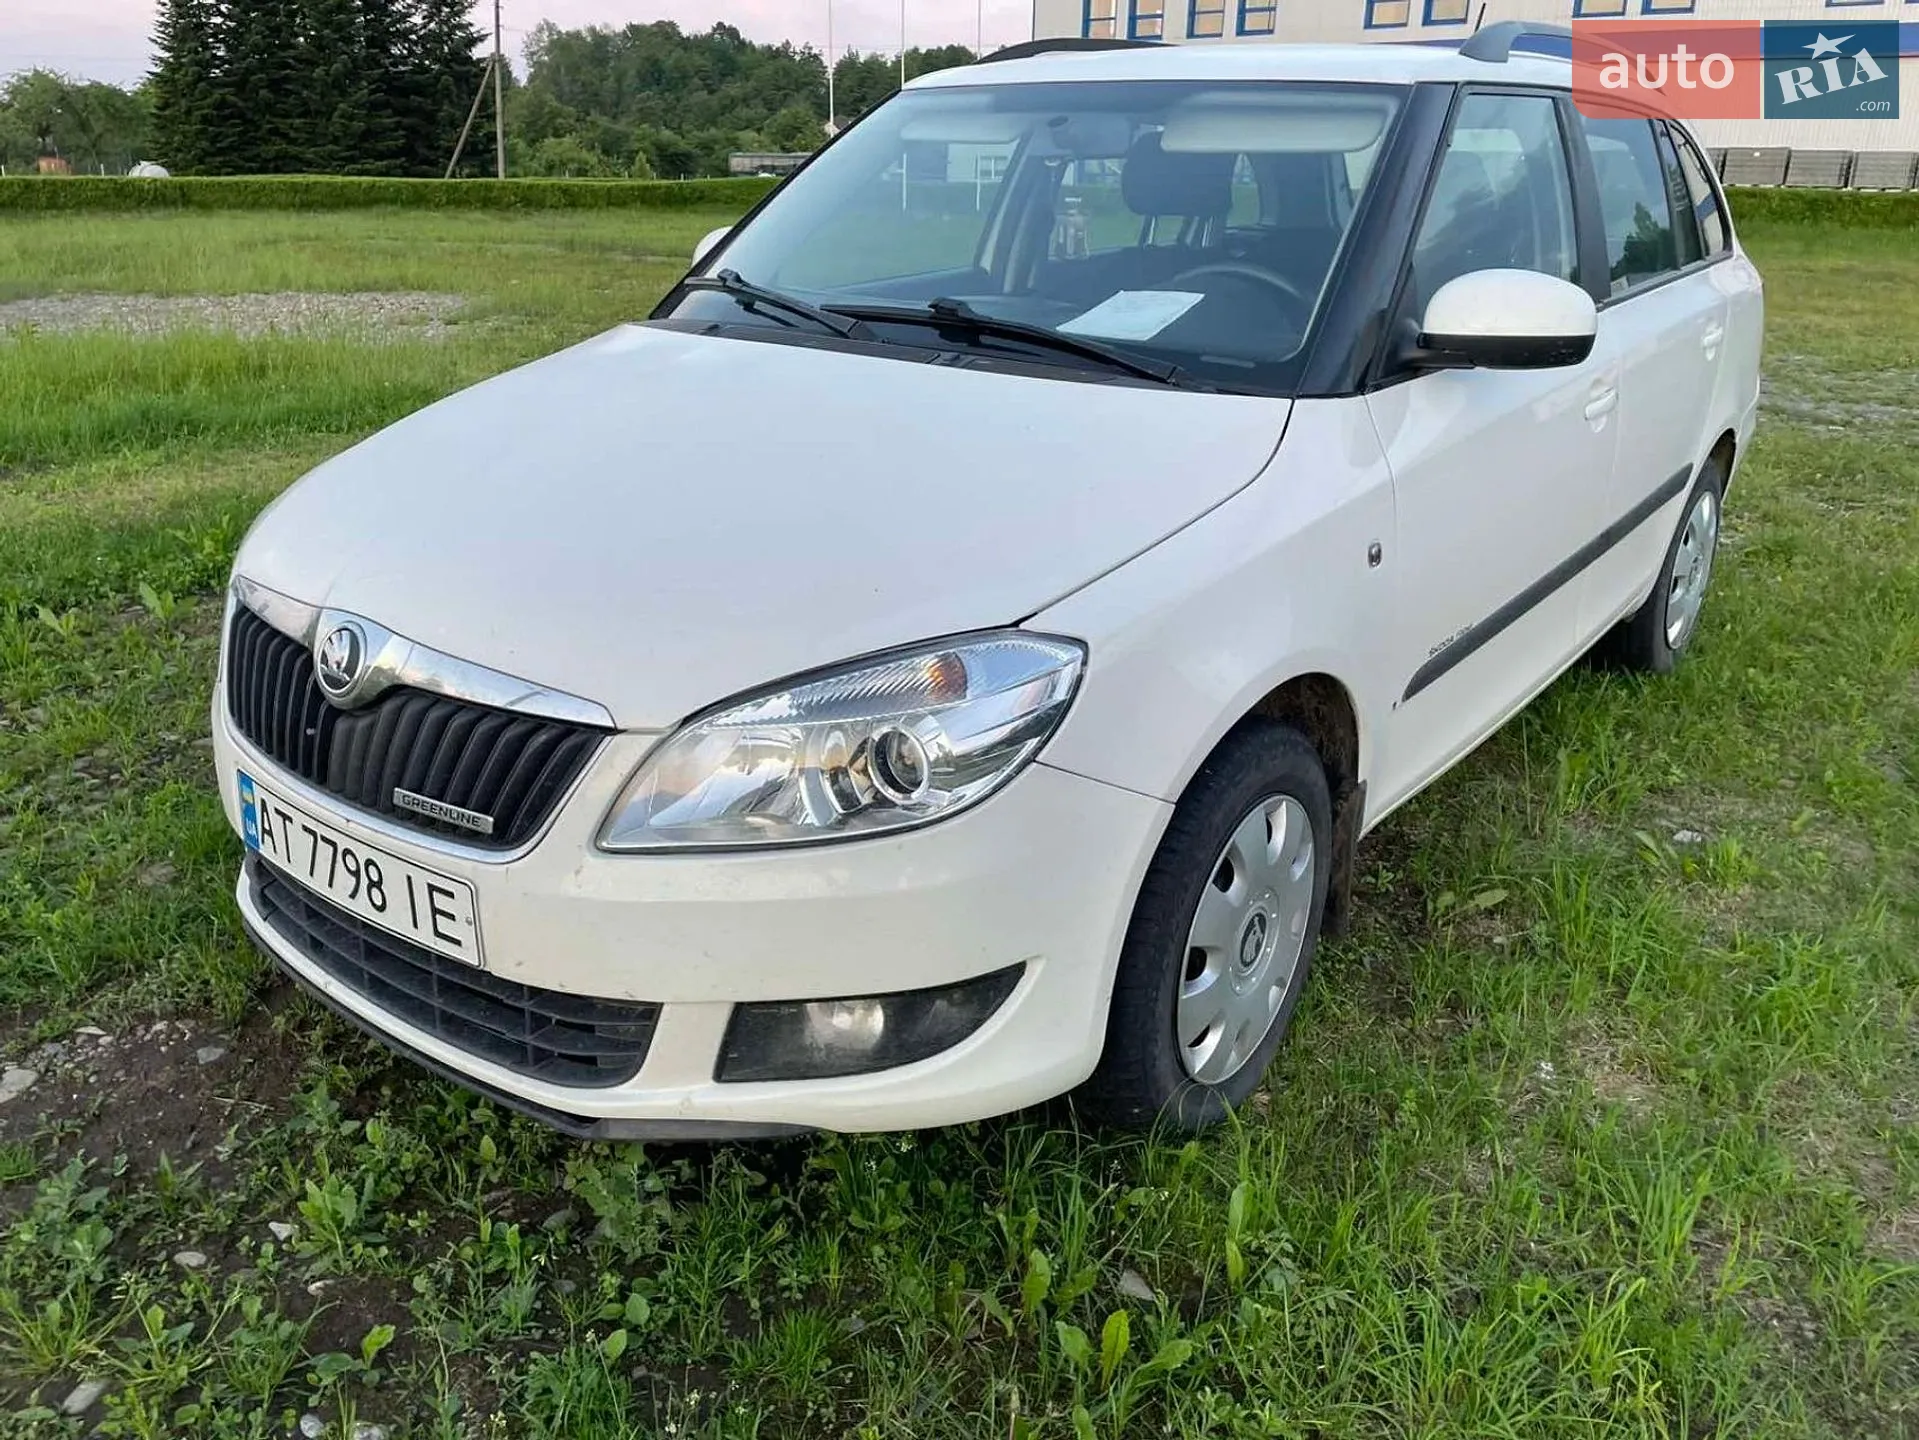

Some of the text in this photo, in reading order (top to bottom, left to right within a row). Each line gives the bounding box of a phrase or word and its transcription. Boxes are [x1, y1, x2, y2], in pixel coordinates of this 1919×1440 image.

[401, 794, 481, 828] GREENLINE
[260, 797, 463, 947] AT 7798 IE
